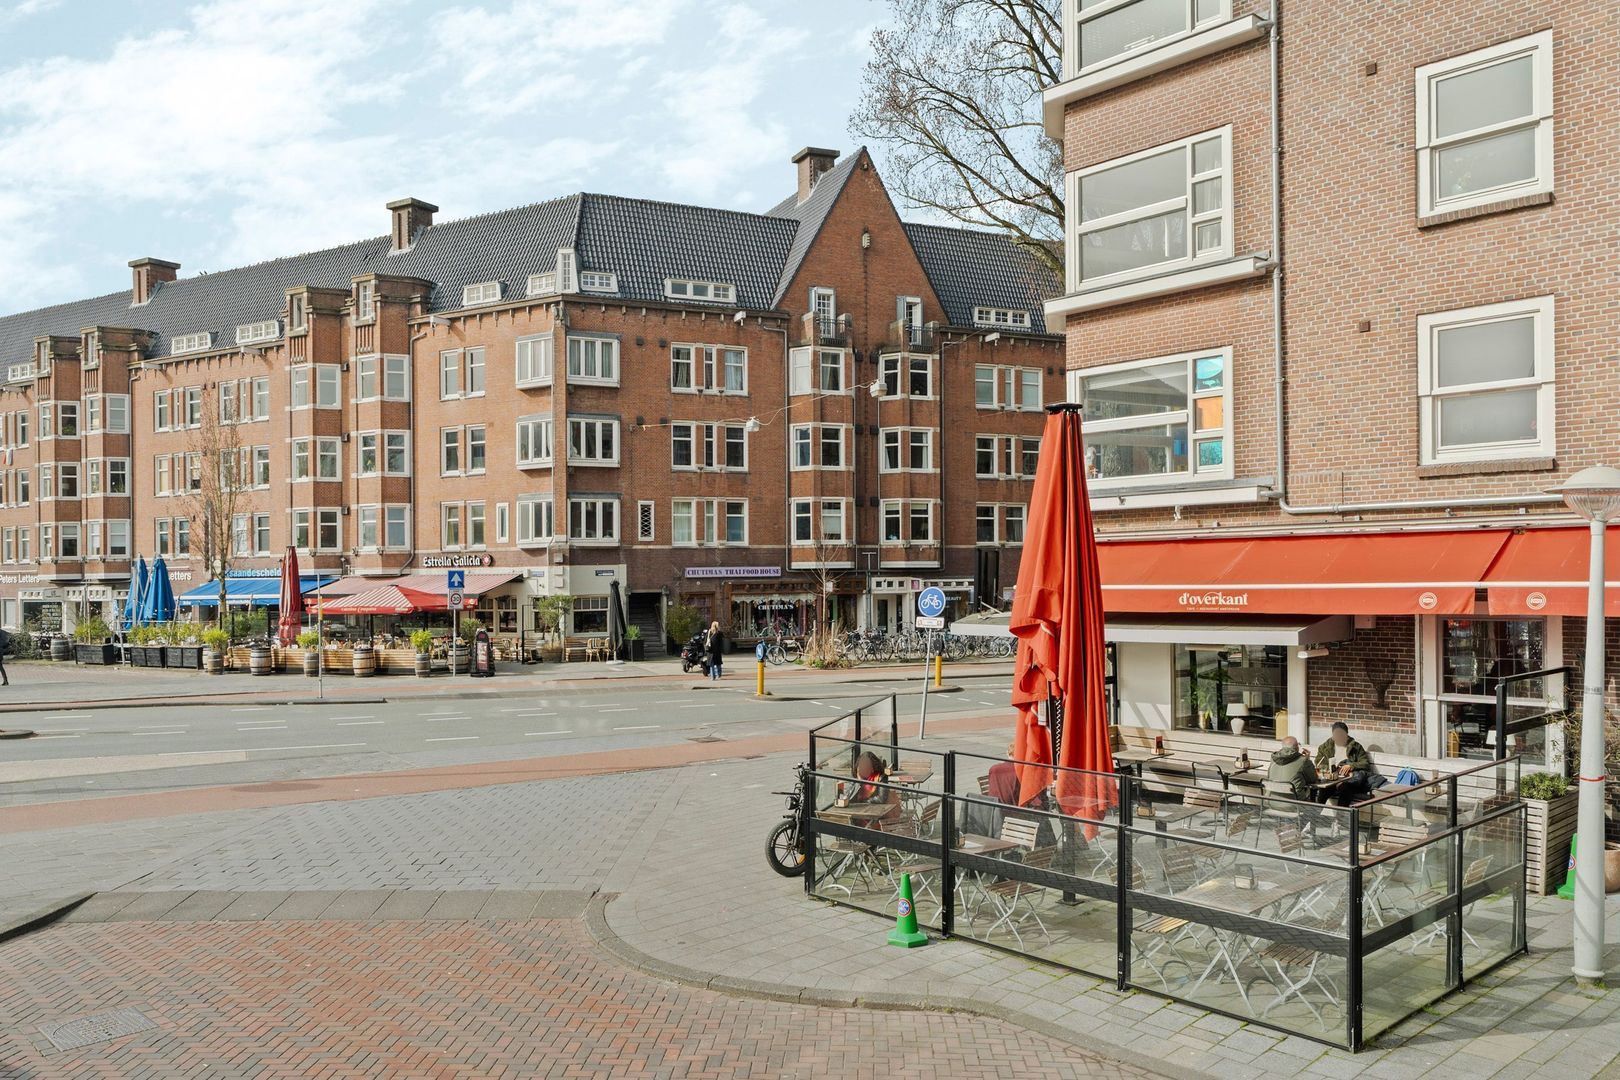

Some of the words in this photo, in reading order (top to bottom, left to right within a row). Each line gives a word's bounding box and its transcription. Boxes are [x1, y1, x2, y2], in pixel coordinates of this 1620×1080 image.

[423, 556, 452, 567] Estrella
[452, 555, 480, 567] Galicia
[18, 573, 40, 584] Letters
[169, 570, 192, 581] etters
[1179, 591, 1249, 605] d'overkant
